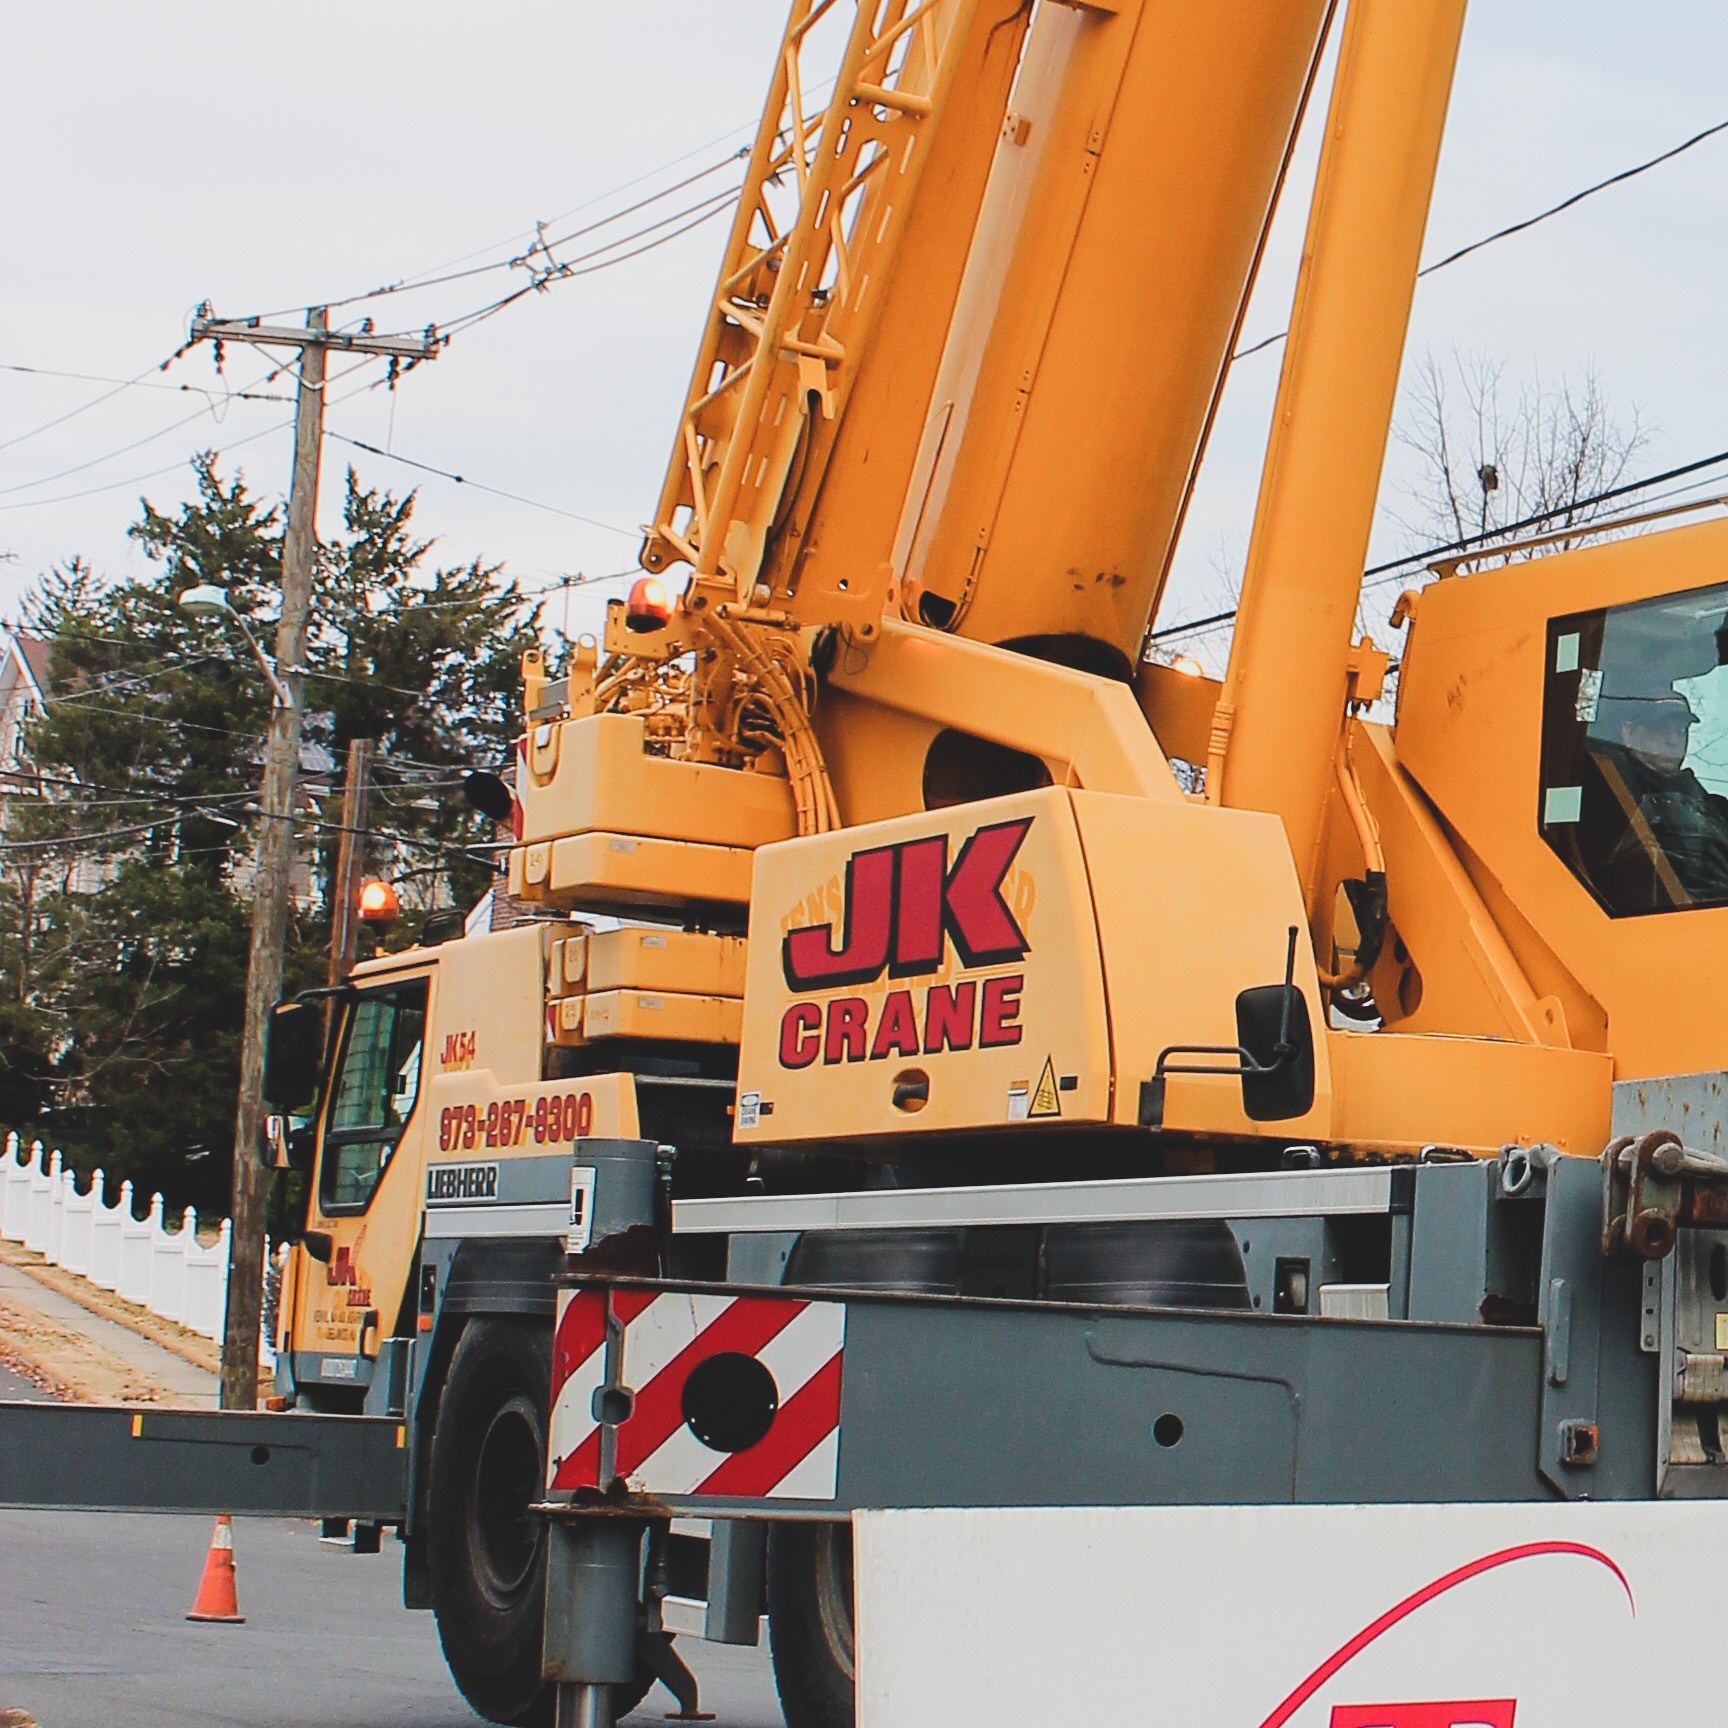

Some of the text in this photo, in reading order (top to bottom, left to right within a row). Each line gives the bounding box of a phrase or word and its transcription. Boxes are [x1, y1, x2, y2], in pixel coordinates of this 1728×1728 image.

[783, 816, 1036, 992] JK
[440, 1030, 476, 1064] JK54
[779, 974, 1024, 1069] CRANE
[427, 1166, 497, 1200] LIEBHERR
